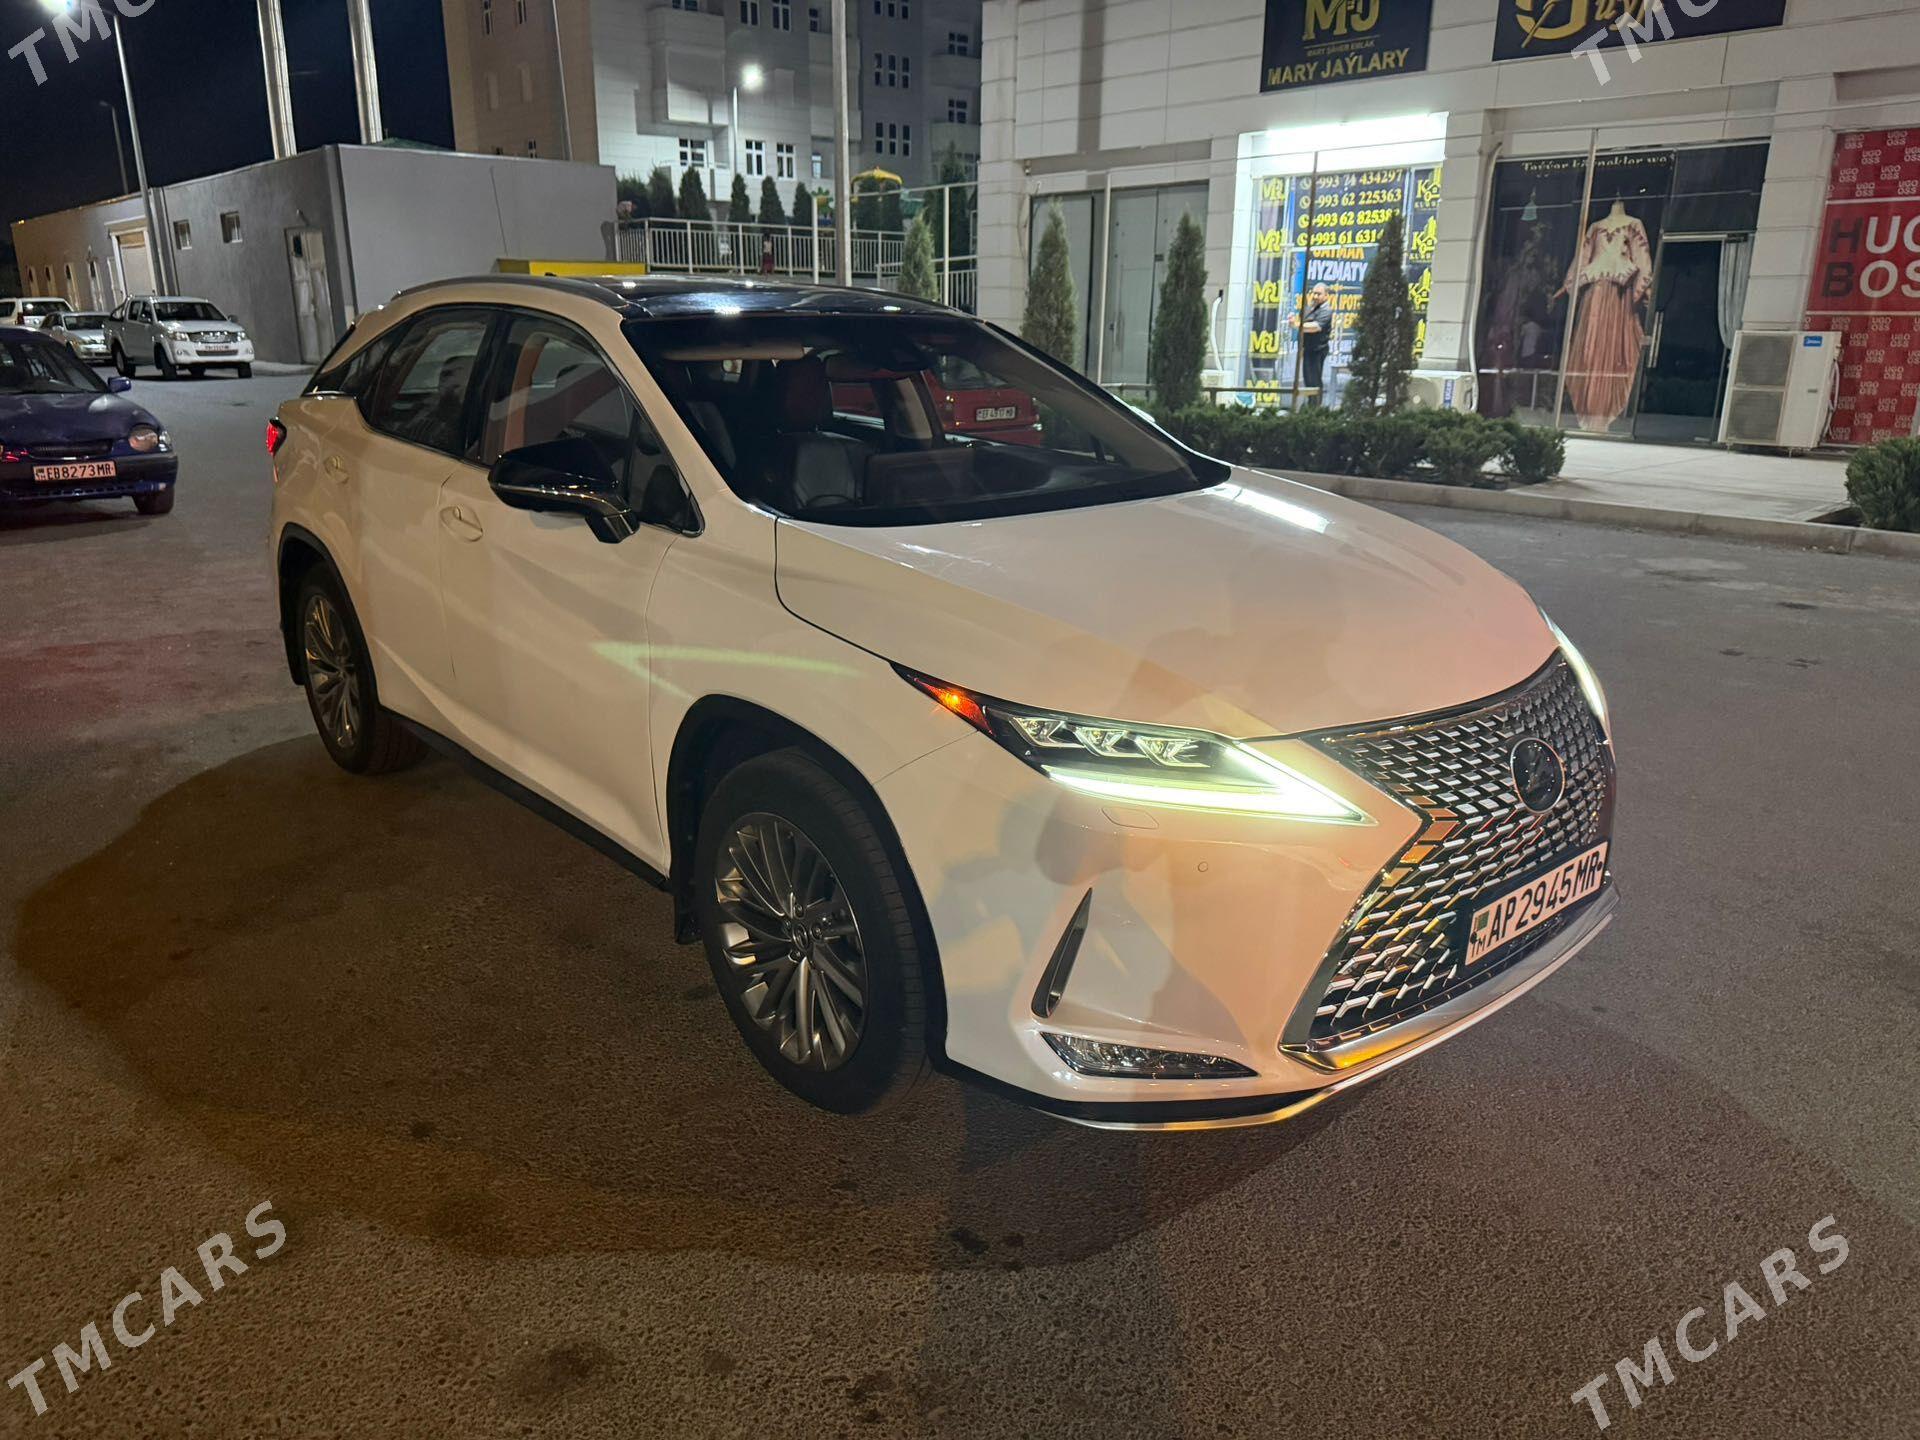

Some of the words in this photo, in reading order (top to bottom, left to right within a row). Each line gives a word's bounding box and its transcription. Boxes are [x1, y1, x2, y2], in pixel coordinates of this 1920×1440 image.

[1268, 62, 1318, 86] MARY
[1321, 48, 1410, 79] JAÝLARY
[1341, 192, 1356, 206] 62
[1358, 188, 1402, 206] 225363
[1340, 211, 1355, 226] 62
[1338, 230, 1353, 245] 61
[1307, 259, 1369, 283] HYZMATY
[1487, 850, 1600, 947] AP2945MR
